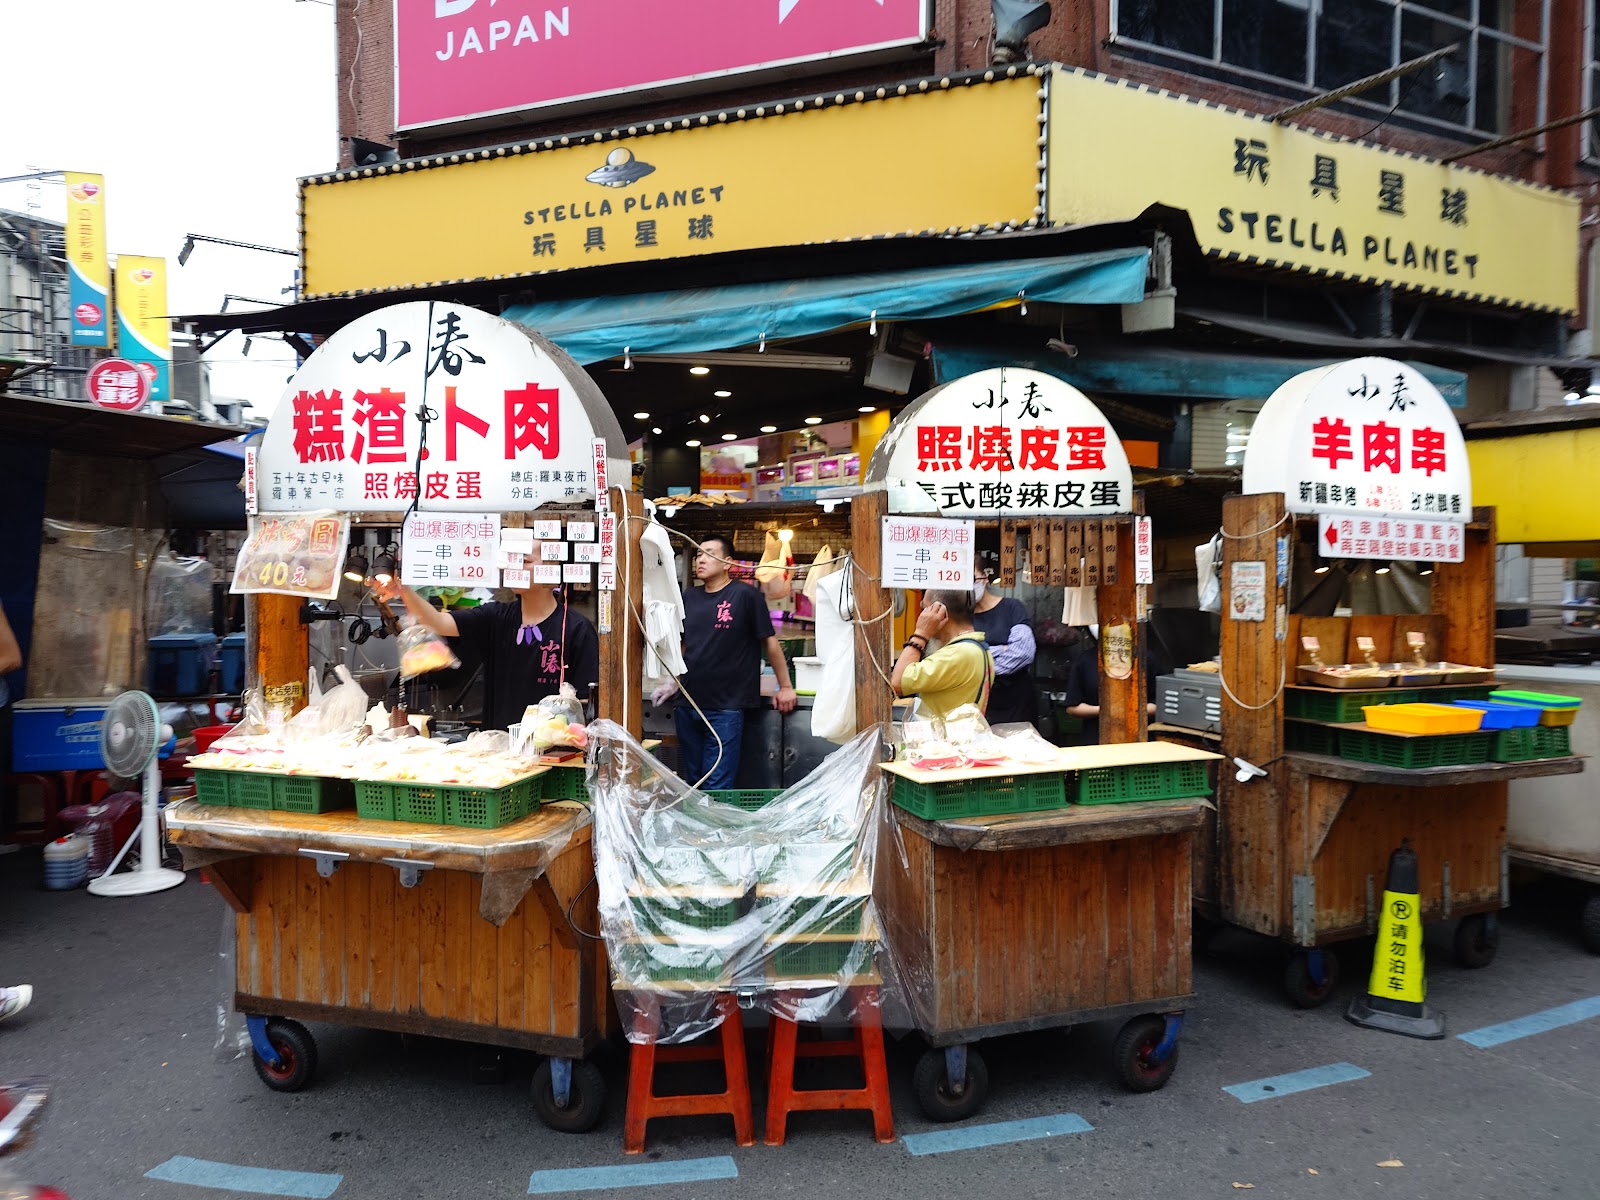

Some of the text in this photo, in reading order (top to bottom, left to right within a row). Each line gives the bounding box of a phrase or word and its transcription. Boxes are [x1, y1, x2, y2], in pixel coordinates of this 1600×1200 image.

[436, 6, 570, 61] JAPAN
[1234, 137, 1469, 227] 玩具星球
[524, 185, 725, 226] STELLA PLANET
[532, 214, 716, 257] 玩具星球
[1217, 207, 1479, 280] STELLA PLANET
[352, 311, 487, 377] 小春
[972, 381, 1053, 420] 小春
[1347, 371, 1418, 413] 小春
[916, 425, 1107, 473] 照燒皮蛋
[1311, 415, 1447, 478] 羊肉串
[272, 471, 344, 485] 五十年古早味
[272, 487, 345, 500] 羅東第一家
[363, 470, 482, 501] 照燒皮蛋
[595, 444, 609, 506] 取餐靠右
[416, 544, 481, 560] 一串 45
[573, 532, 585, 540] 130
[601, 517, 614, 585] 塑膠袋一元
[896, 548, 958, 563] 一串 45
[412, 563, 484, 579] 三串 120
[893, 566, 961, 582] 三串 120
